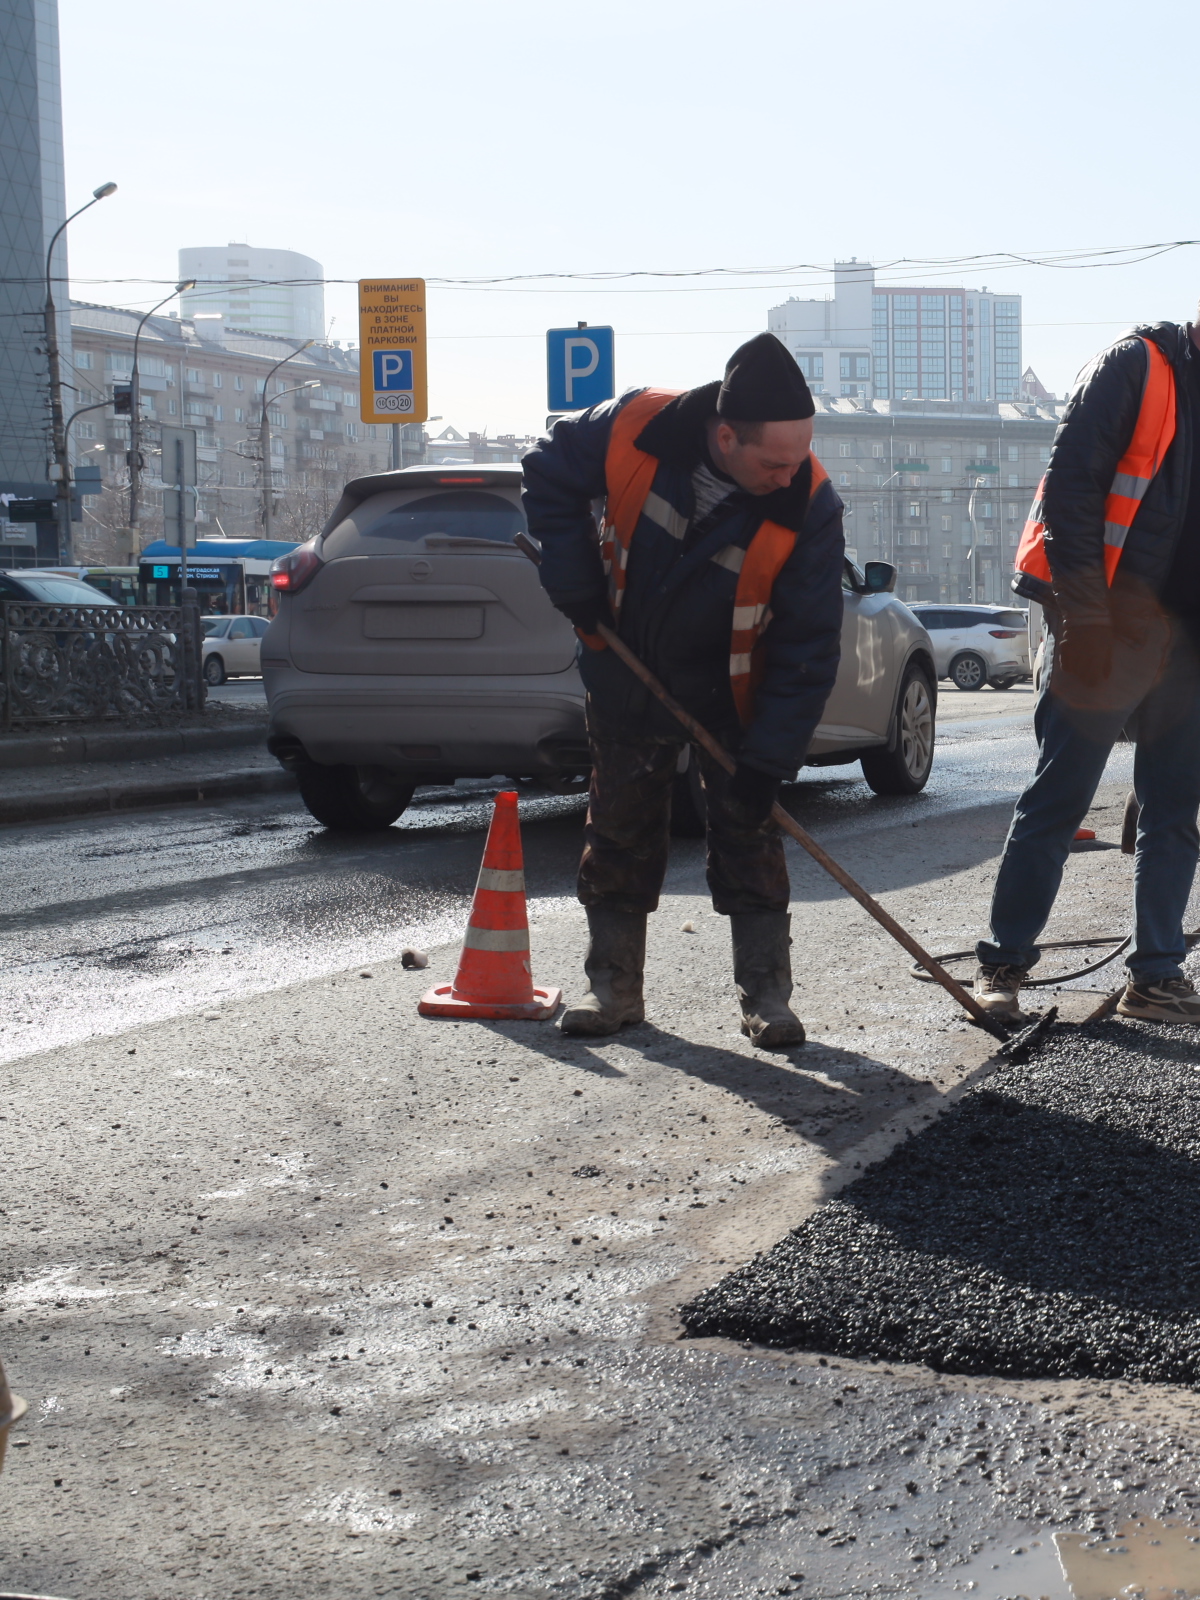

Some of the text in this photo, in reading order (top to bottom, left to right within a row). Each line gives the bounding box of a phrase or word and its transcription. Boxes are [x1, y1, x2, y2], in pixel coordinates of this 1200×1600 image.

[363, 283, 419, 293] ВНИМАНИЕ!
[383, 294, 399, 303] ВЫ
[360, 304, 423, 314] НАХОДИТЕСЬ
[375, 315, 409, 324] В ЗОНЕ
[370, 323, 415, 334] ПЛАТНОЙ
[367, 336, 417, 345] ПАРКОВКИ
[381, 354, 403, 388] P
[564, 337, 600, 403] P
[400, 398, 409, 407] 20
[156, 566, 164, 577] 5
